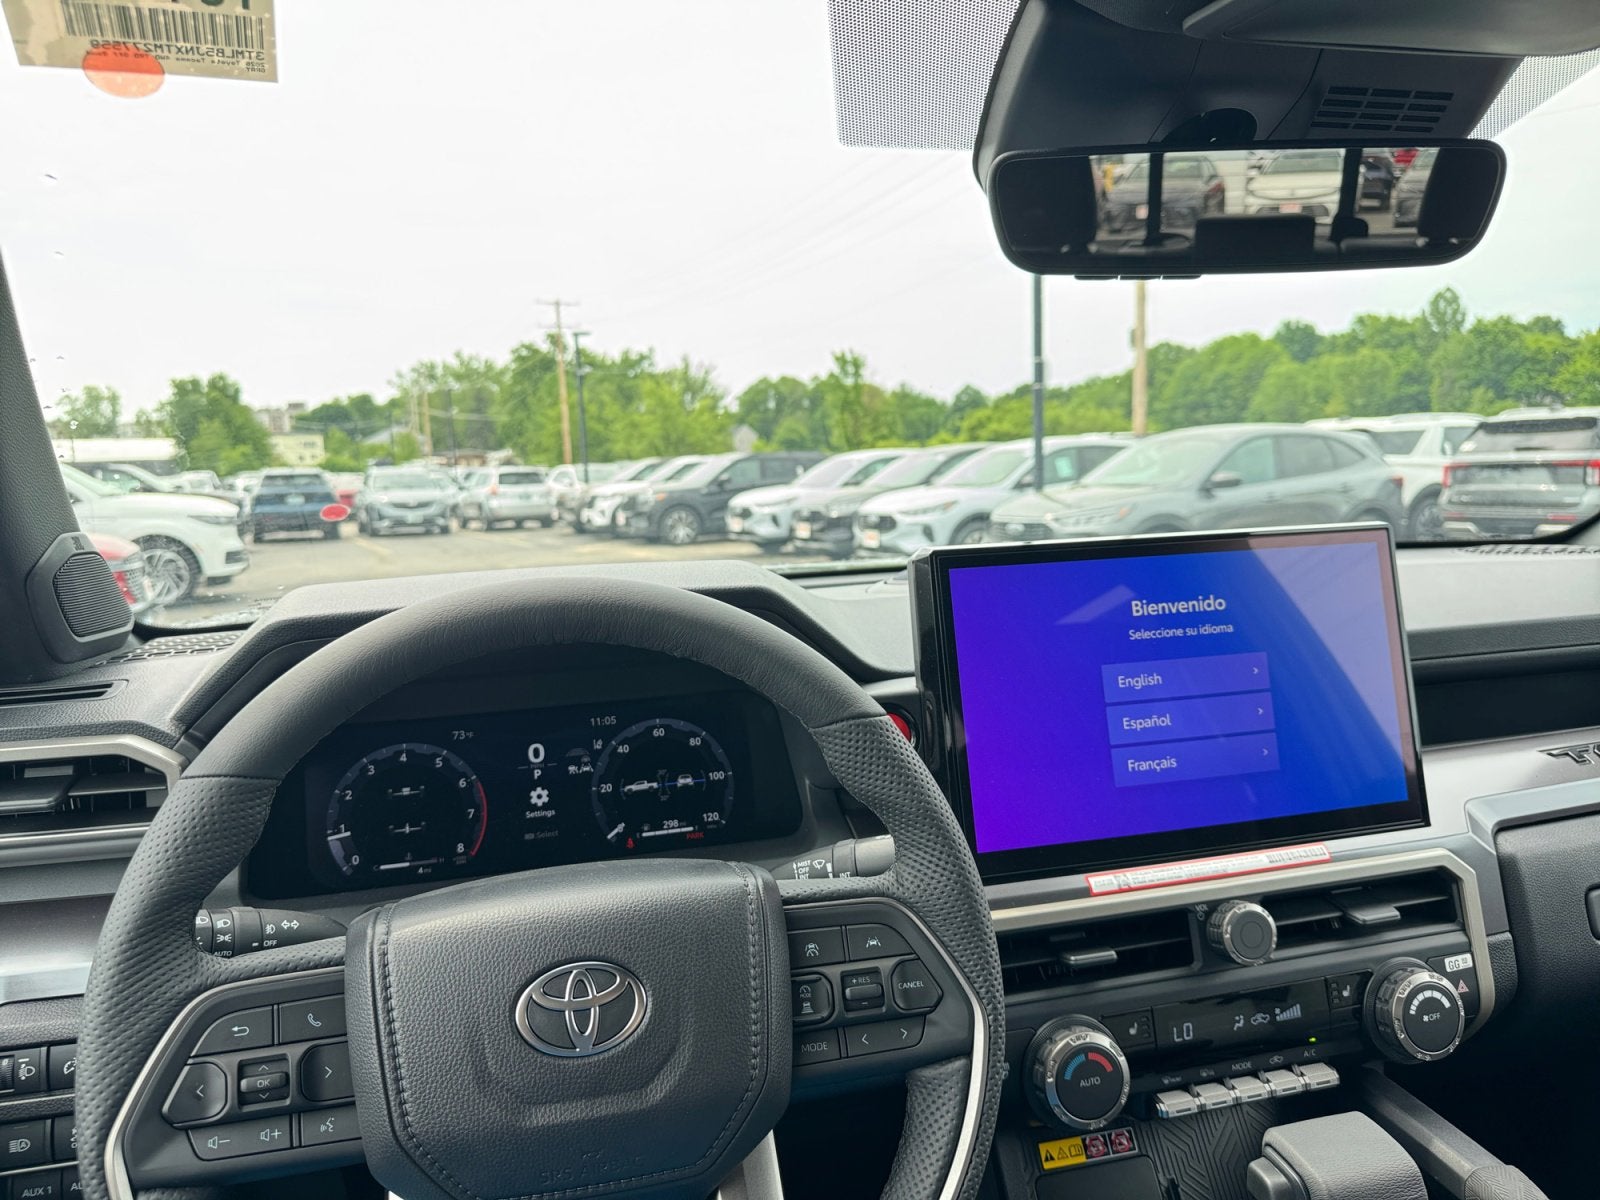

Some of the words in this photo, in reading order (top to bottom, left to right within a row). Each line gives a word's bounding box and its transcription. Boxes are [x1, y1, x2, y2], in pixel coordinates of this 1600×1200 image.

[1131, 595, 1226, 616] Bienvenido
[1128, 627, 1184, 640] Seleccione
[1185, 627, 1198, 636] su
[1199, 624, 1234, 635] idioma
[1118, 673, 1162, 689] English
[590, 716, 616, 727] 11:05
[1122, 714, 1171, 731] Español
[653, 728, 665, 737] 60
[689, 737, 701, 747] 80
[617, 744, 630, 754] 40
[399, 753, 407, 762] 4
[435, 757, 443, 768] 5
[1127, 756, 1177, 772] Français
[367, 765, 376, 775] 3
[534, 769, 542, 780] P
[708, 771, 725, 781] 100
[458, 778, 467, 788] 6
[600, 784, 612, 793] 20
[344, 790, 352, 800] 2
[468, 809, 474, 819] 7
[526, 809, 556, 818] Settings
[703, 812, 719, 822] 120
[663, 820, 679, 829] 298
[456, 843, 464, 853] 8
[352, 856, 360, 865] 0
[798, 860, 810, 868] MIST
[1448, 960, 1460, 971] GG
[898, 980, 924, 990] CANCEL
[1428, 1012, 1440, 1021] OFF
[1173, 1022, 1194, 1043] LO
[801, 1041, 828, 1053] MODE
[1232, 1062, 1252, 1072] MODE
[257, 1080, 270, 1088] OK
[1080, 1076, 1100, 1088] AUTO
[22, 1189, 44, 1198] AUX
